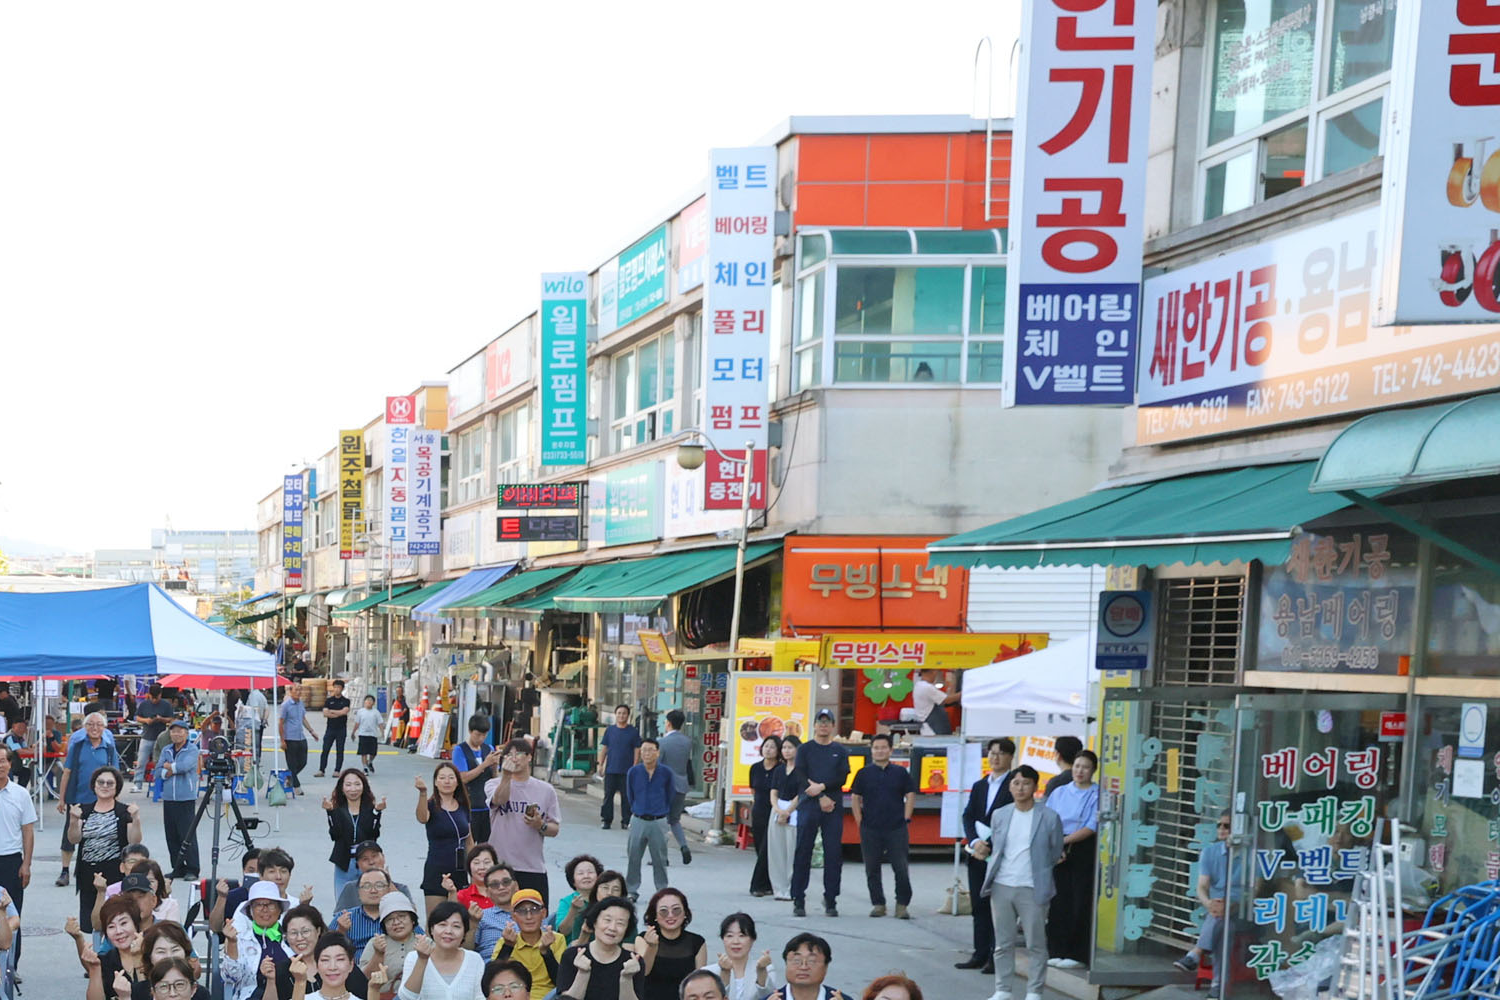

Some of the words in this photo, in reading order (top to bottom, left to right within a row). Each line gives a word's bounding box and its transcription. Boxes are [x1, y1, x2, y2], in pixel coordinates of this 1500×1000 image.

[714, 164, 768, 189] 벨트
[714, 216, 768, 236] 베어링
[543, 277, 584, 294] wilo
[714, 261, 767, 287] 체인
[1026, 294, 1133, 322] 베어링
[713, 309, 765, 335] 풀리
[1149, 263, 1278, 387] 새한기공
[1023, 328, 1129, 357] 체인
[548, 304, 578, 437] 윌로펌프
[712, 357, 763, 382] 모터
[1023, 364, 1126, 393] V벨트
[1144, 407, 1170, 435] TEL:
[1171, 395, 1229, 431] 743-6121
[1245, 388, 1276, 418] FAX:
[1278, 372, 1350, 409] 743-6122
[1372, 361, 1408, 395] TEL:
[1411, 343, 1500, 389] 742-4423
[711, 405, 762, 430] 펌프
[413, 433, 435, 444] 서울
[285, 478, 302, 491] 모터
[342, 434, 361, 520] 원주철물
[284, 494, 302, 506] 공구
[415, 446, 433, 540] 목공기계공구
[709, 482, 762, 501] 중전기
[284, 541, 302, 553] 수리
[1286, 533, 1391, 582] 새한기공
[809, 563, 949, 600] 무빙스낵
[1110, 605, 1141, 622] 담배
[1273, 590, 1398, 641] 용남베어링
[831, 641, 926, 665] 무빙스낵
[1104, 645, 1140, 654] KTRA
[754, 685, 793, 695] 대한민국
[703, 733, 720, 783] 베어링
[1261, 746, 1380, 789] 베어링
[1259, 796, 1376, 837] U-패킹
[1256, 844, 1369, 885] V-벨트
